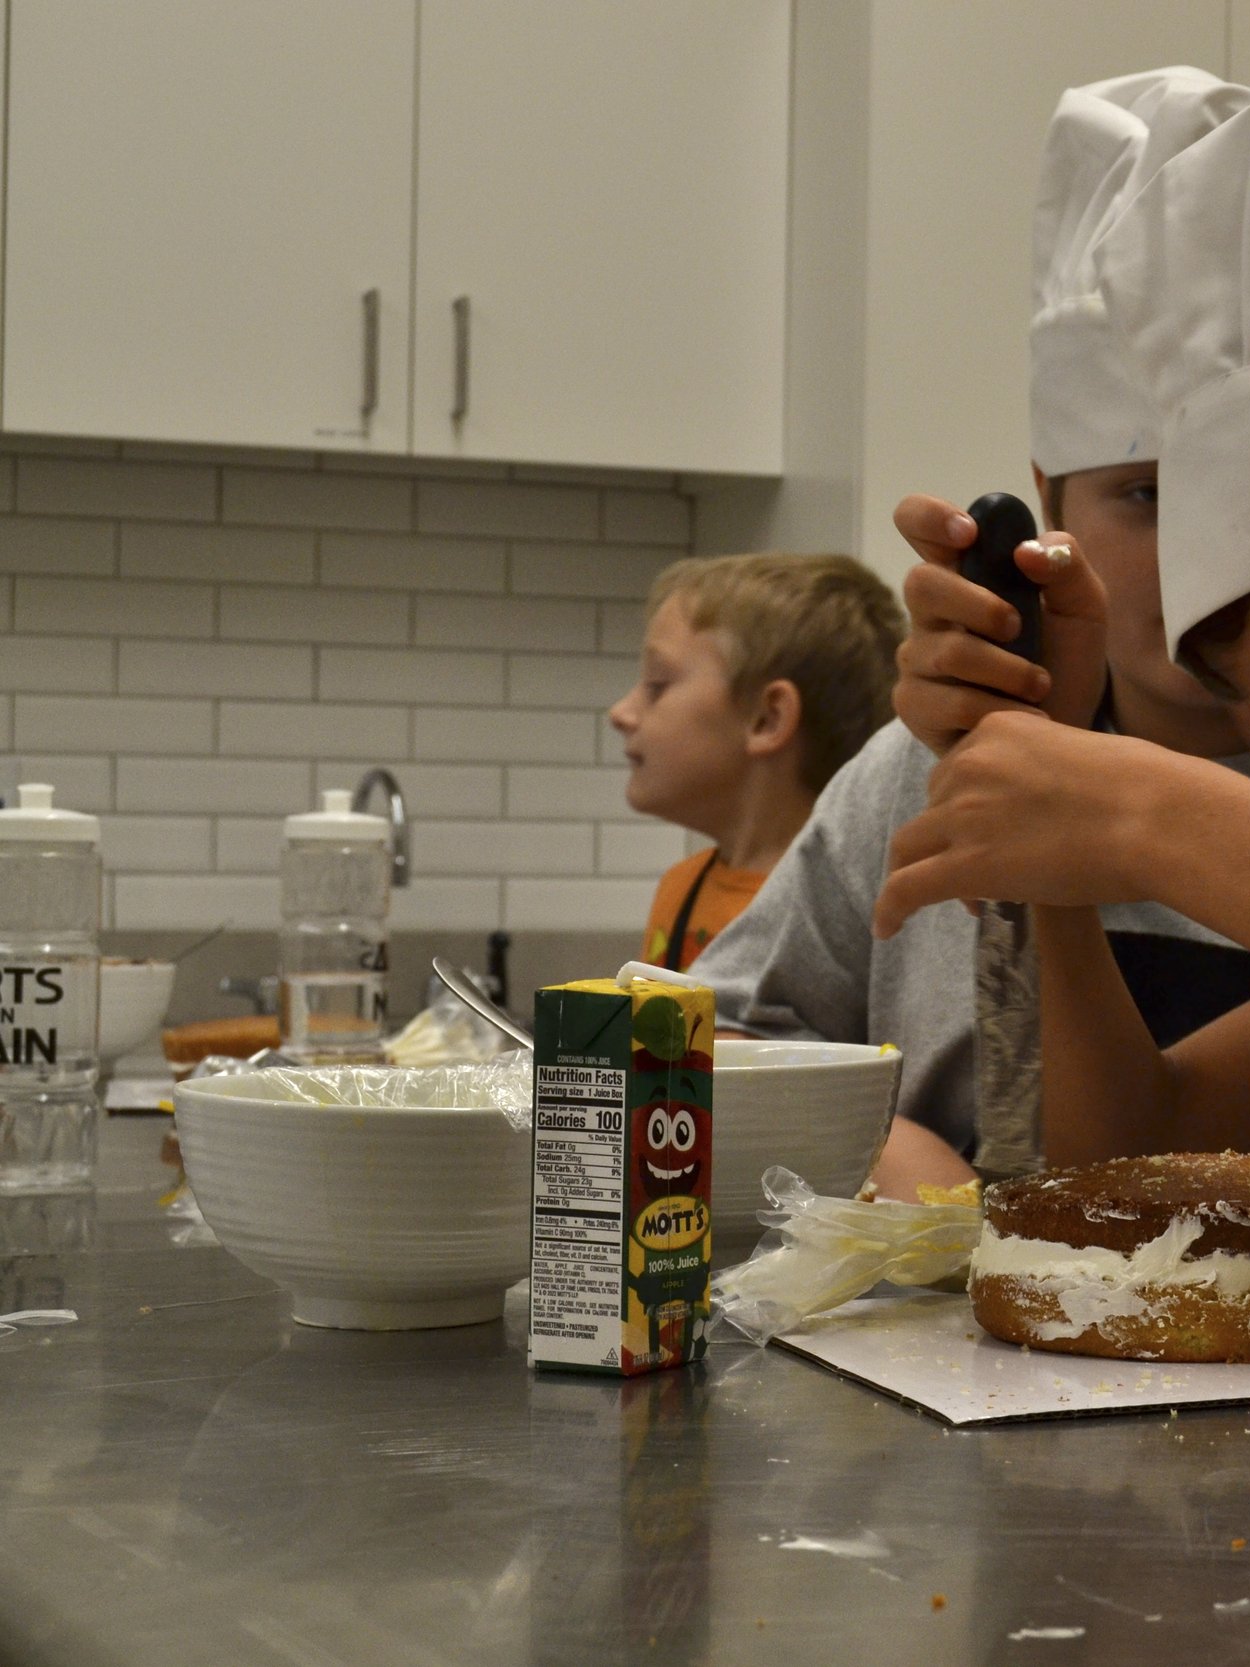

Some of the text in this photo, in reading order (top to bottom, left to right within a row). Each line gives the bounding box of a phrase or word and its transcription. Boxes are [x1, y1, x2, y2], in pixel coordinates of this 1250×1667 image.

[0, 968, 64, 1004] TS
[0, 1028, 57, 1064] IN
[557, 1055, 584, 1064] CONTAINS
[597, 1057, 610, 1066] JUICE
[539, 1068, 623, 1085] Nutrition Facts
[538, 1085, 623, 1098] Serving size 1 Juice Box
[537, 1110, 622, 1130] Calories 100
[595, 1134, 607, 1142] Daily
[537, 1141, 553, 1149] Total
[555, 1142, 566, 1150] Fat
[612, 1146, 621, 1154] 0%
[537, 1153, 562, 1161] Sodium
[564, 1154, 582, 1163] 25mg
[537, 1164, 553, 1172] Total
[554, 1165, 572, 1173] Carb.
[574, 1166, 585, 1175] 24g
[542, 1175, 592, 1186] Total Sugars 23g
[548, 1186, 559, 1194] Incl.
[569, 1188, 585, 1196] Added
[586, 1189, 603, 1198] Sugars
[611, 1191, 621, 1199] 0%
[536, 1197, 570, 1207] Protein 0g
[641, 1207, 704, 1238] MOTT'S
[535, 1227, 553, 1236] Vitamin
[554, 1228, 559, 1236] C
[549, 1242, 570, 1250] significant
[648, 1255, 699, 1273] 100% Juice
[533, 1321, 598, 1332] UNSWEETENED PASTEURIZED
[533, 1328, 595, 1340] REFRIGERATE AFTER OPENING
